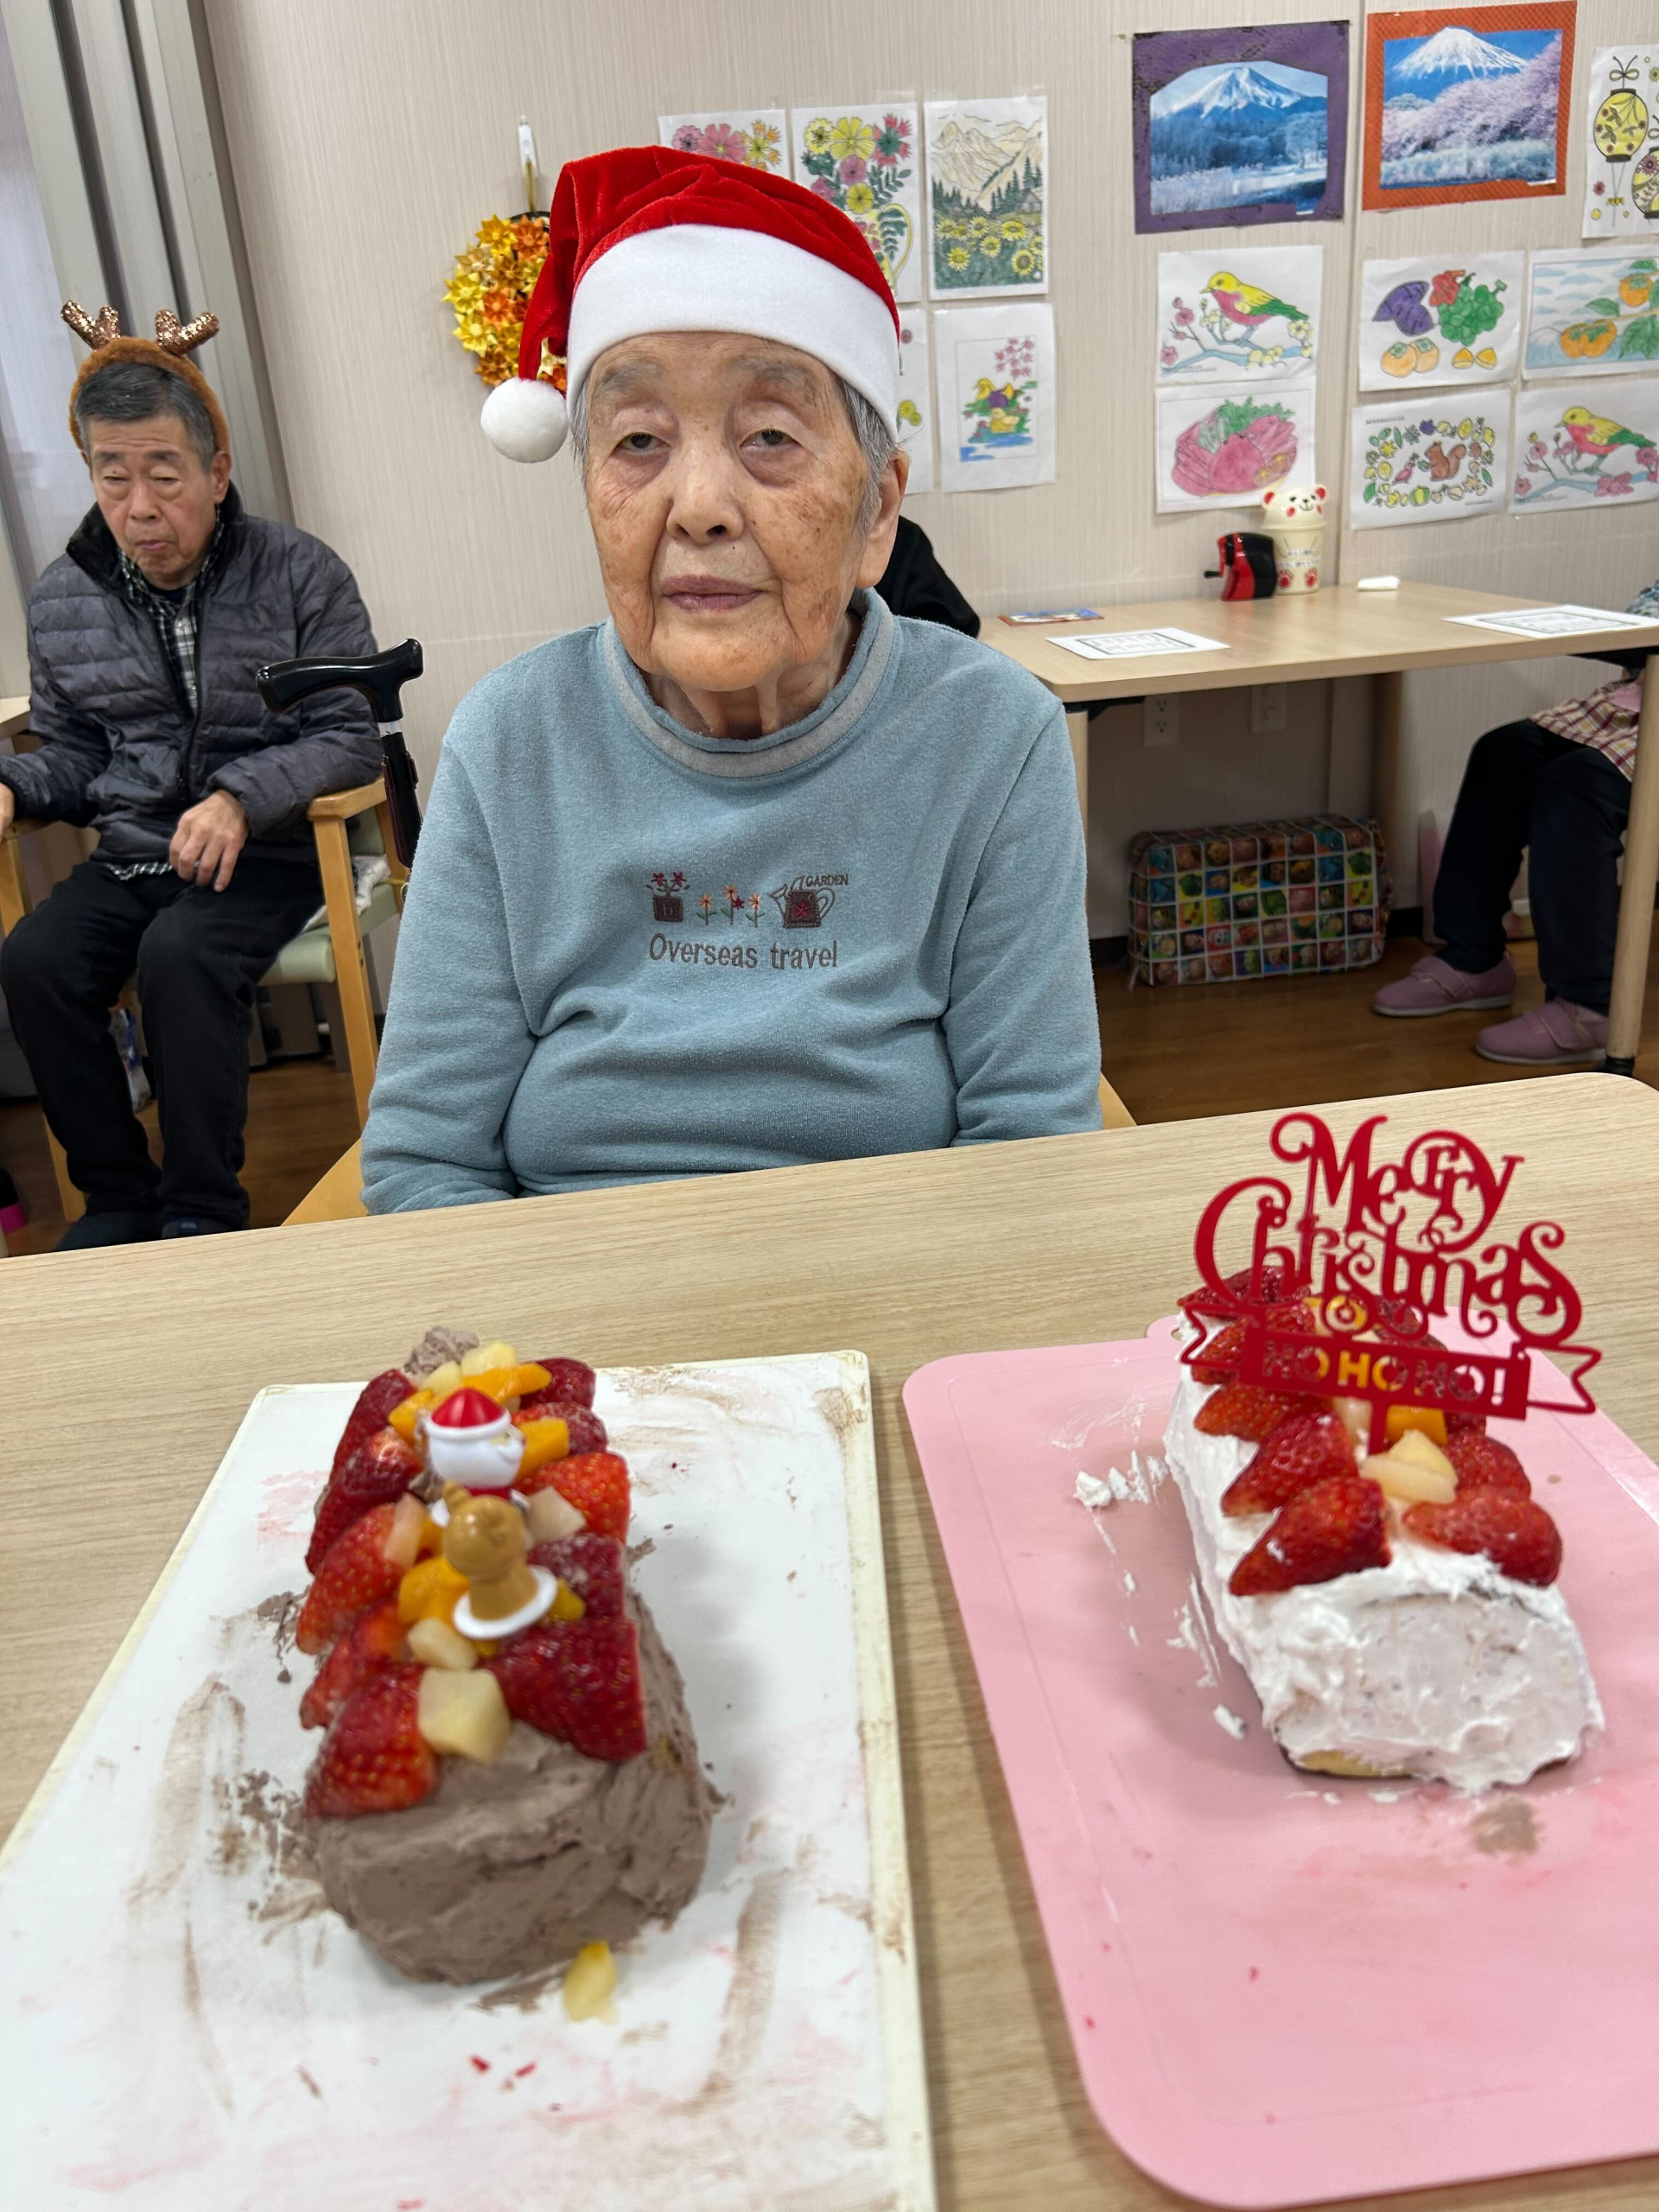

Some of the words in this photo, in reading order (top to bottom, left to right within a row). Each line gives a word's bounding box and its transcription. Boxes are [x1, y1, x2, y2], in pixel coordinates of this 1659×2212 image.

[805, 873, 849, 887] GARDEN
[650, 933, 758, 969] Overseas
[770, 940, 837, 969] travel
[1269, 1112, 1524, 1253] Merry
[1194, 1176, 1582, 1348] Christmas
